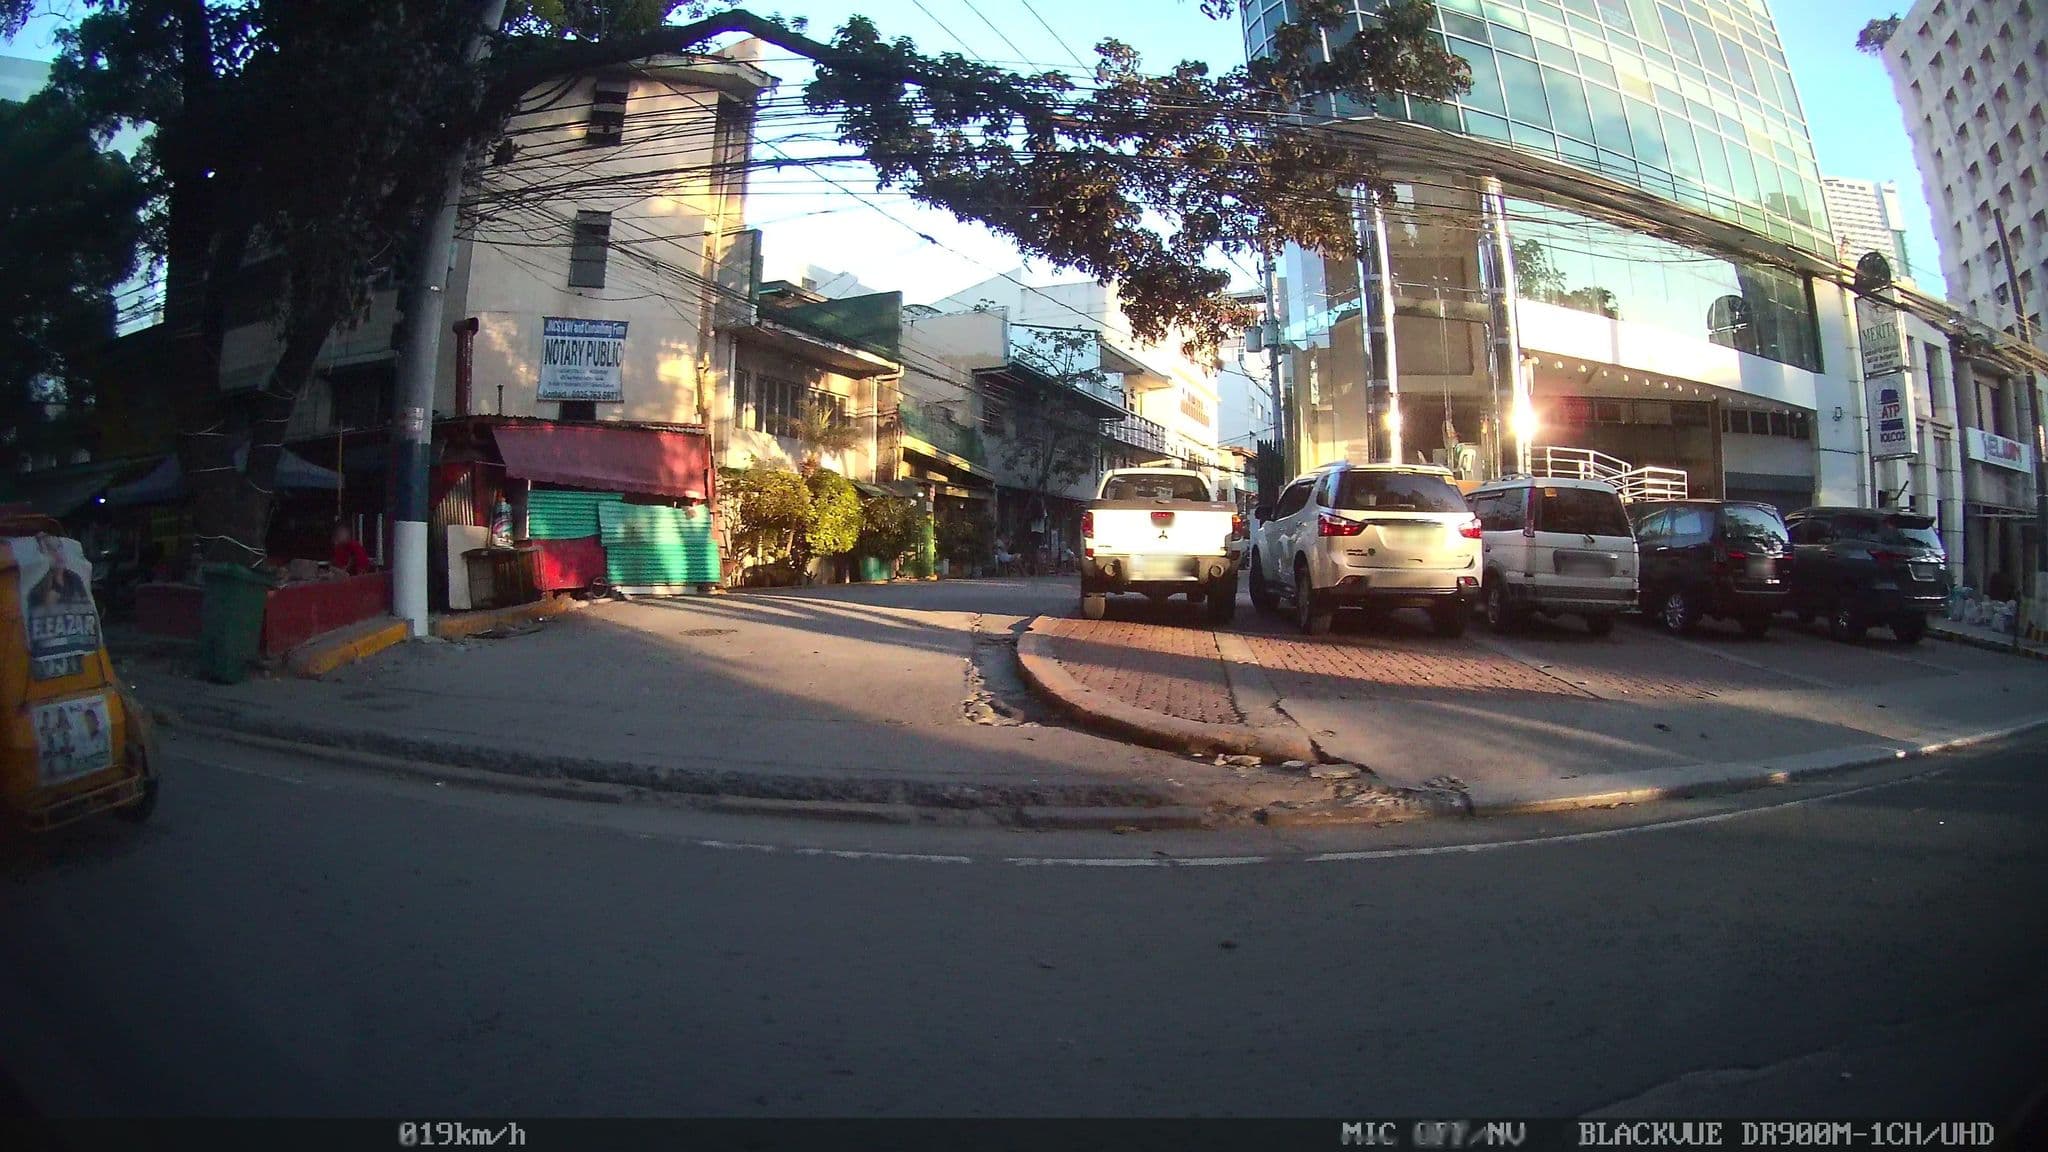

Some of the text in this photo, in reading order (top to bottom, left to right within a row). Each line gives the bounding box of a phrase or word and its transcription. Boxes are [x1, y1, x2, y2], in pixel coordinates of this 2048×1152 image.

[544, 339, 623, 367] NOTARY PUBLIC
[1882, 404, 1900, 419] ATP
